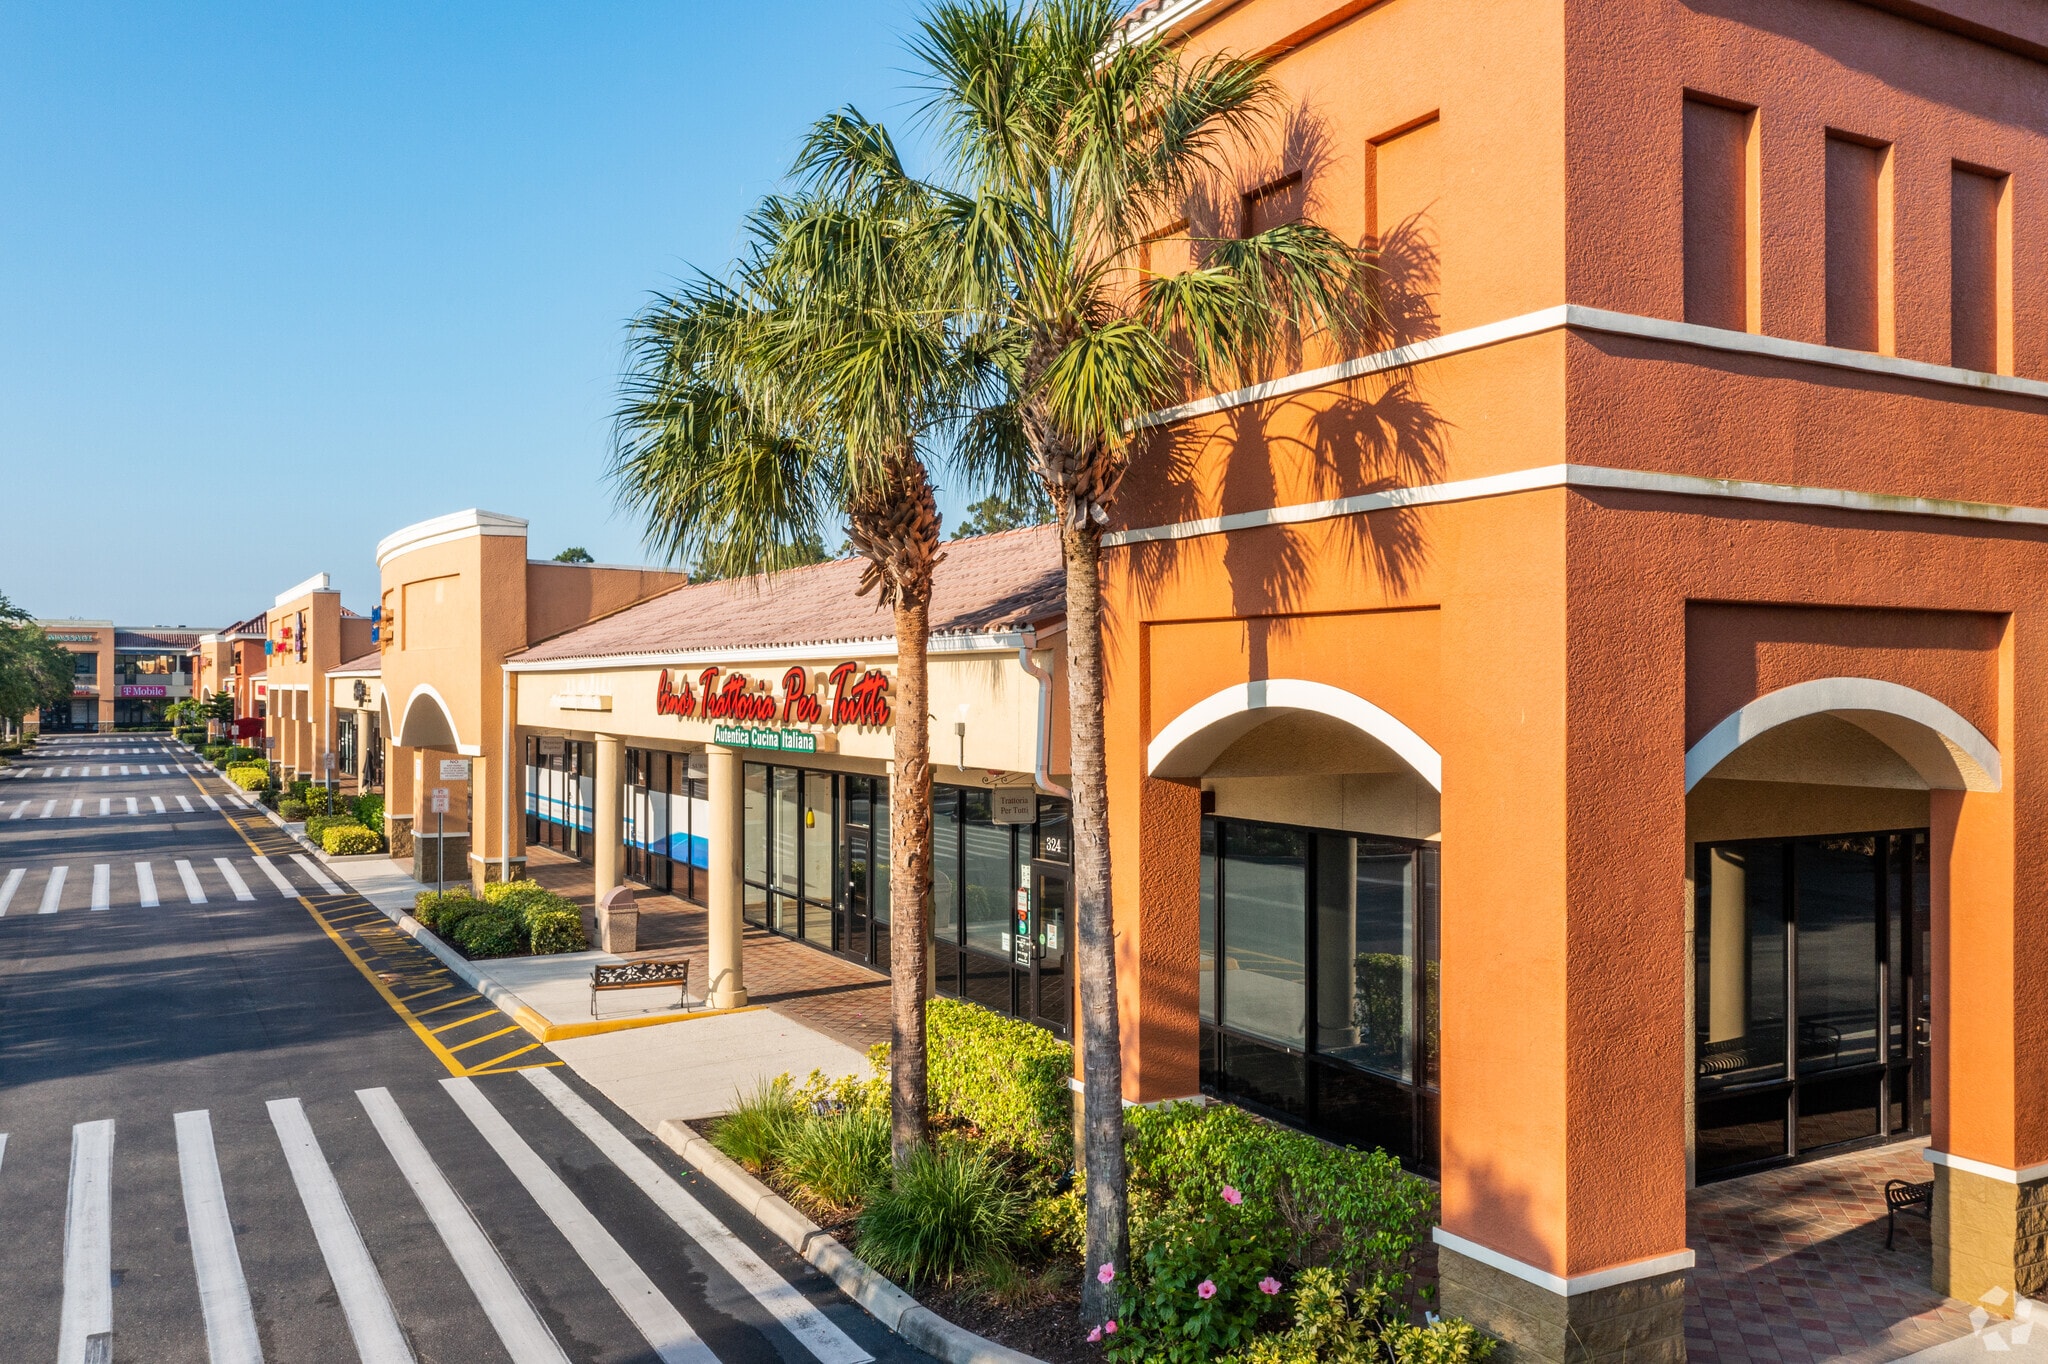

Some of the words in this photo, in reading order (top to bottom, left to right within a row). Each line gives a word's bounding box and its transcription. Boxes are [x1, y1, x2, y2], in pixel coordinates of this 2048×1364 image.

[133, 686, 164, 696] Mobile
[699, 666, 776, 721] Trattoria
[782, 665, 822, 724] Per
[829, 661, 890, 726] Tutti
[715, 726, 749, 745] Autentica
[751, 728, 779, 747] Cucina
[782, 730, 814, 750] Italiana
[1000, 796, 1029, 805] Trattoria
[1000, 806, 1011, 814] Per
[1013, 806, 1029, 814] Tutti
[1046, 837, 1061, 852] 324
